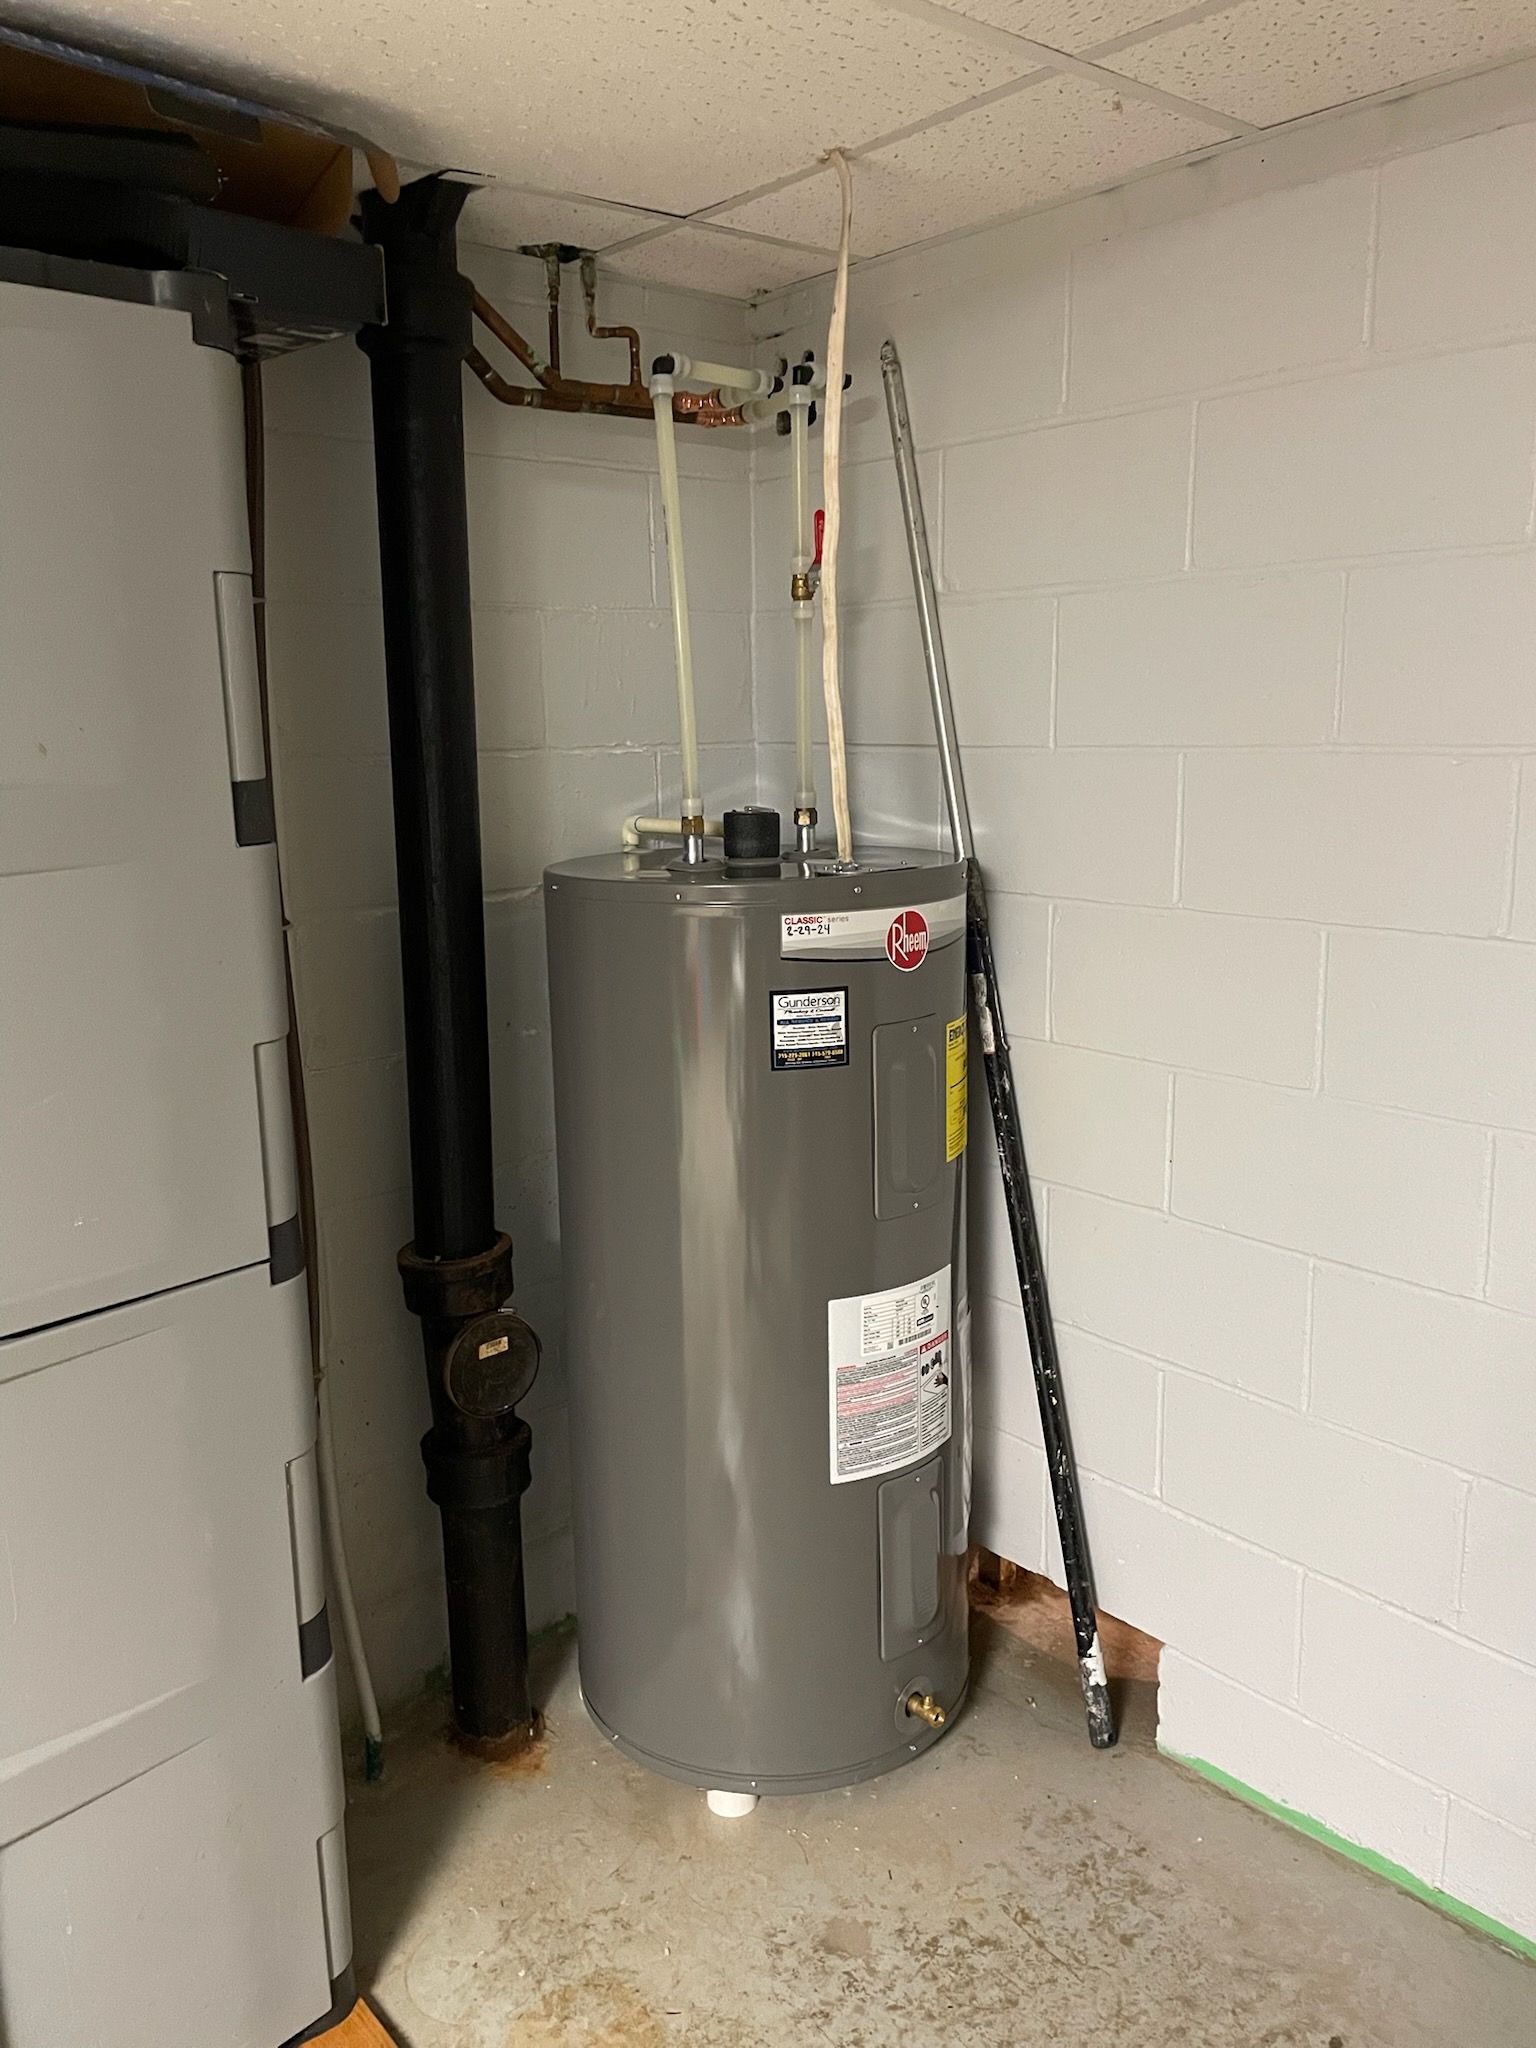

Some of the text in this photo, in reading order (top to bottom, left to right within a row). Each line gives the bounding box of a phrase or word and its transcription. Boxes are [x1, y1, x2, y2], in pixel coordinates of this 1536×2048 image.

[784, 916, 823, 925] CLASSIC
[786, 923, 830, 936] 2-29-24
[892, 912, 928, 961] Rheem
[778, 995, 840, 1008] Gunderson
